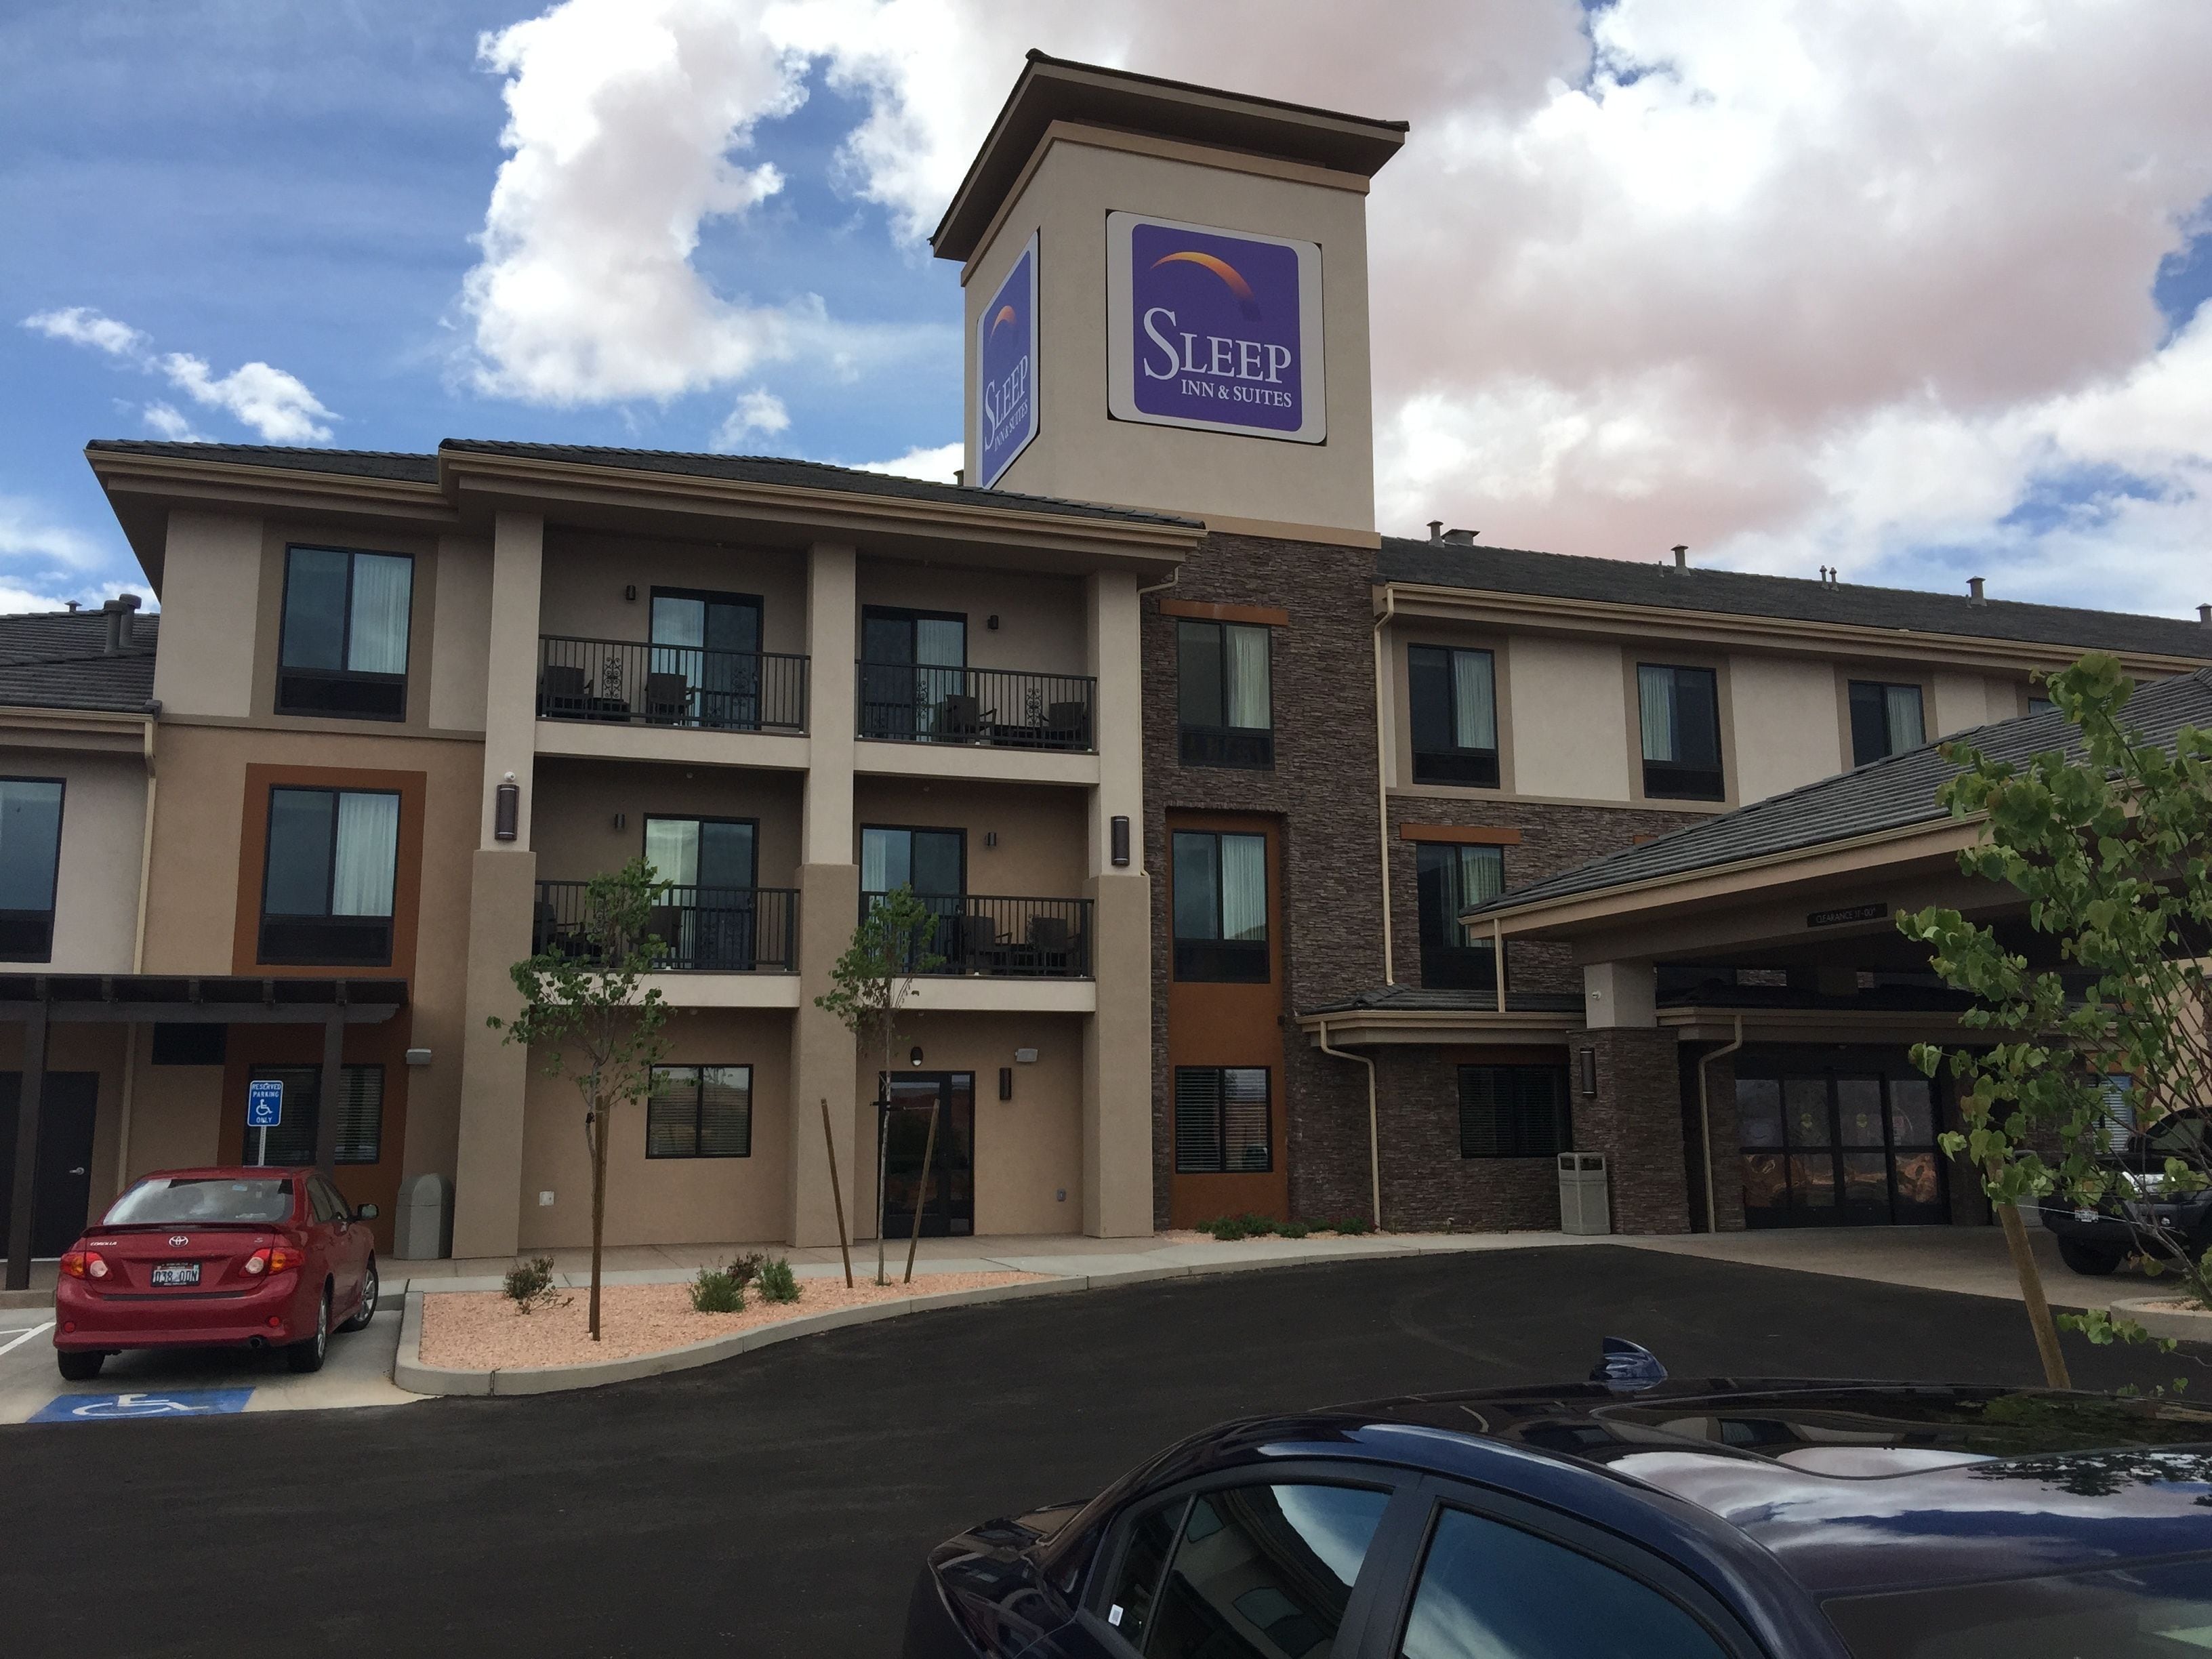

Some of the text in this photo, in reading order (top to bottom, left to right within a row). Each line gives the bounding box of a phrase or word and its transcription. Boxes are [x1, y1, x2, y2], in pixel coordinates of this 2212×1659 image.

[1143, 307, 1292, 384] SLEEP
[985, 355, 1028, 452] SLEEP
[1181, 379, 1292, 408] INN & SUITES
[1009, 398, 1028, 433] SUITES
[1816, 911, 1853, 922] CLEARANCE
